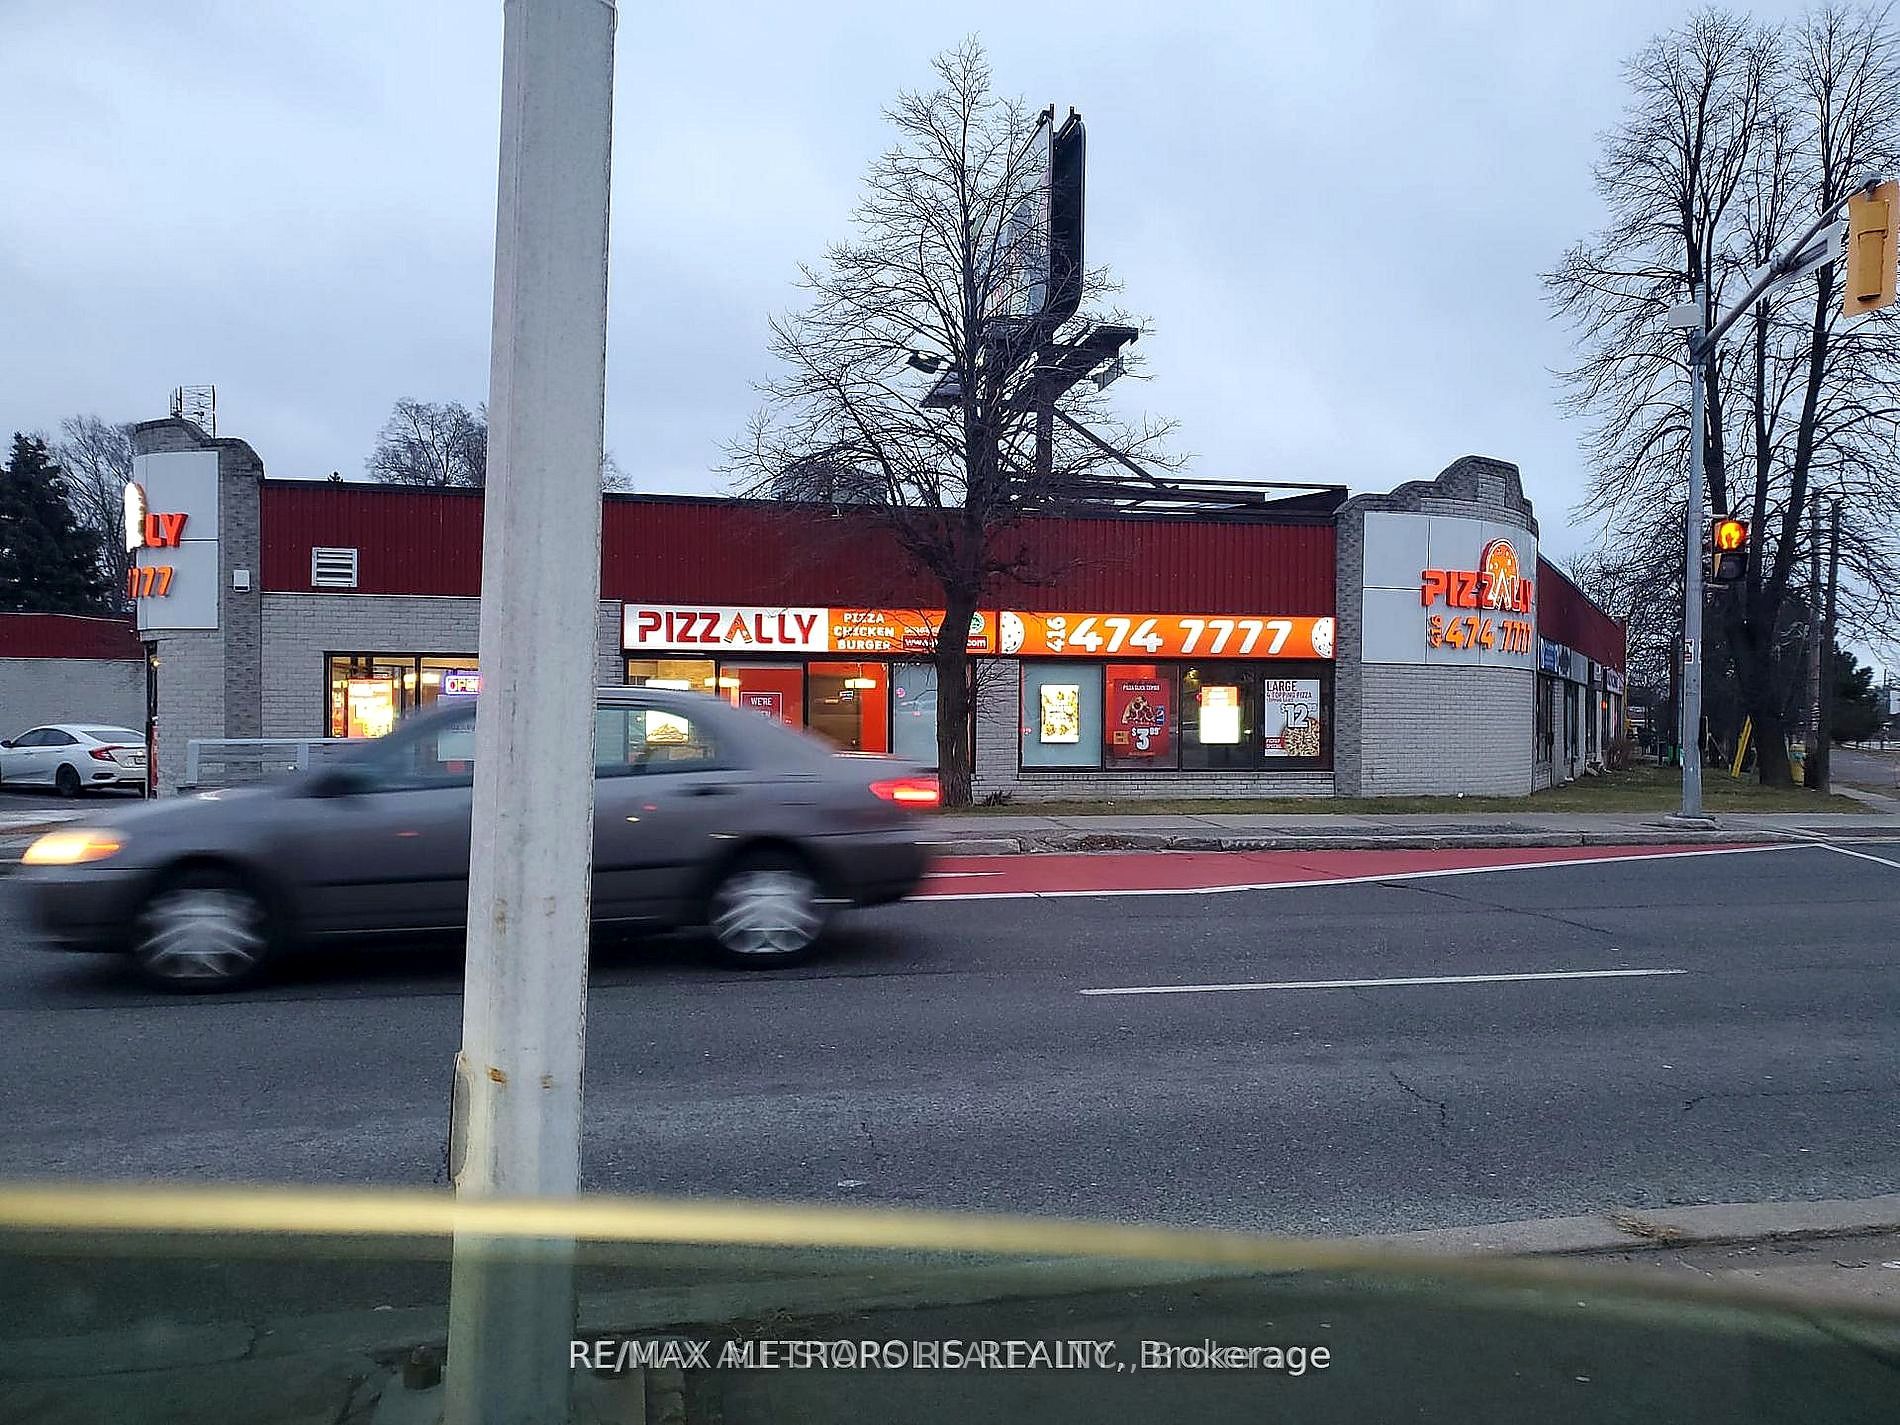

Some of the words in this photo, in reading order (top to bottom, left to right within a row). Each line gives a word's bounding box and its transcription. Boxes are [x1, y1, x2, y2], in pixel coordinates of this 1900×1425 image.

[144, 512, 188, 548] LY
[637, 611, 818, 644] PIZZALLY
[843, 613, 885, 624] PIZZA
[833, 626, 895, 637] CHICKEN
[1046, 616, 1066, 653] 416
[1068, 617, 1163, 653] 474
[1178, 620, 1292, 654] 7777
[1444, 616, 1495, 650] 474
[837, 639, 891, 650] BURGER
[1266, 681, 1297, 692] LARGE
